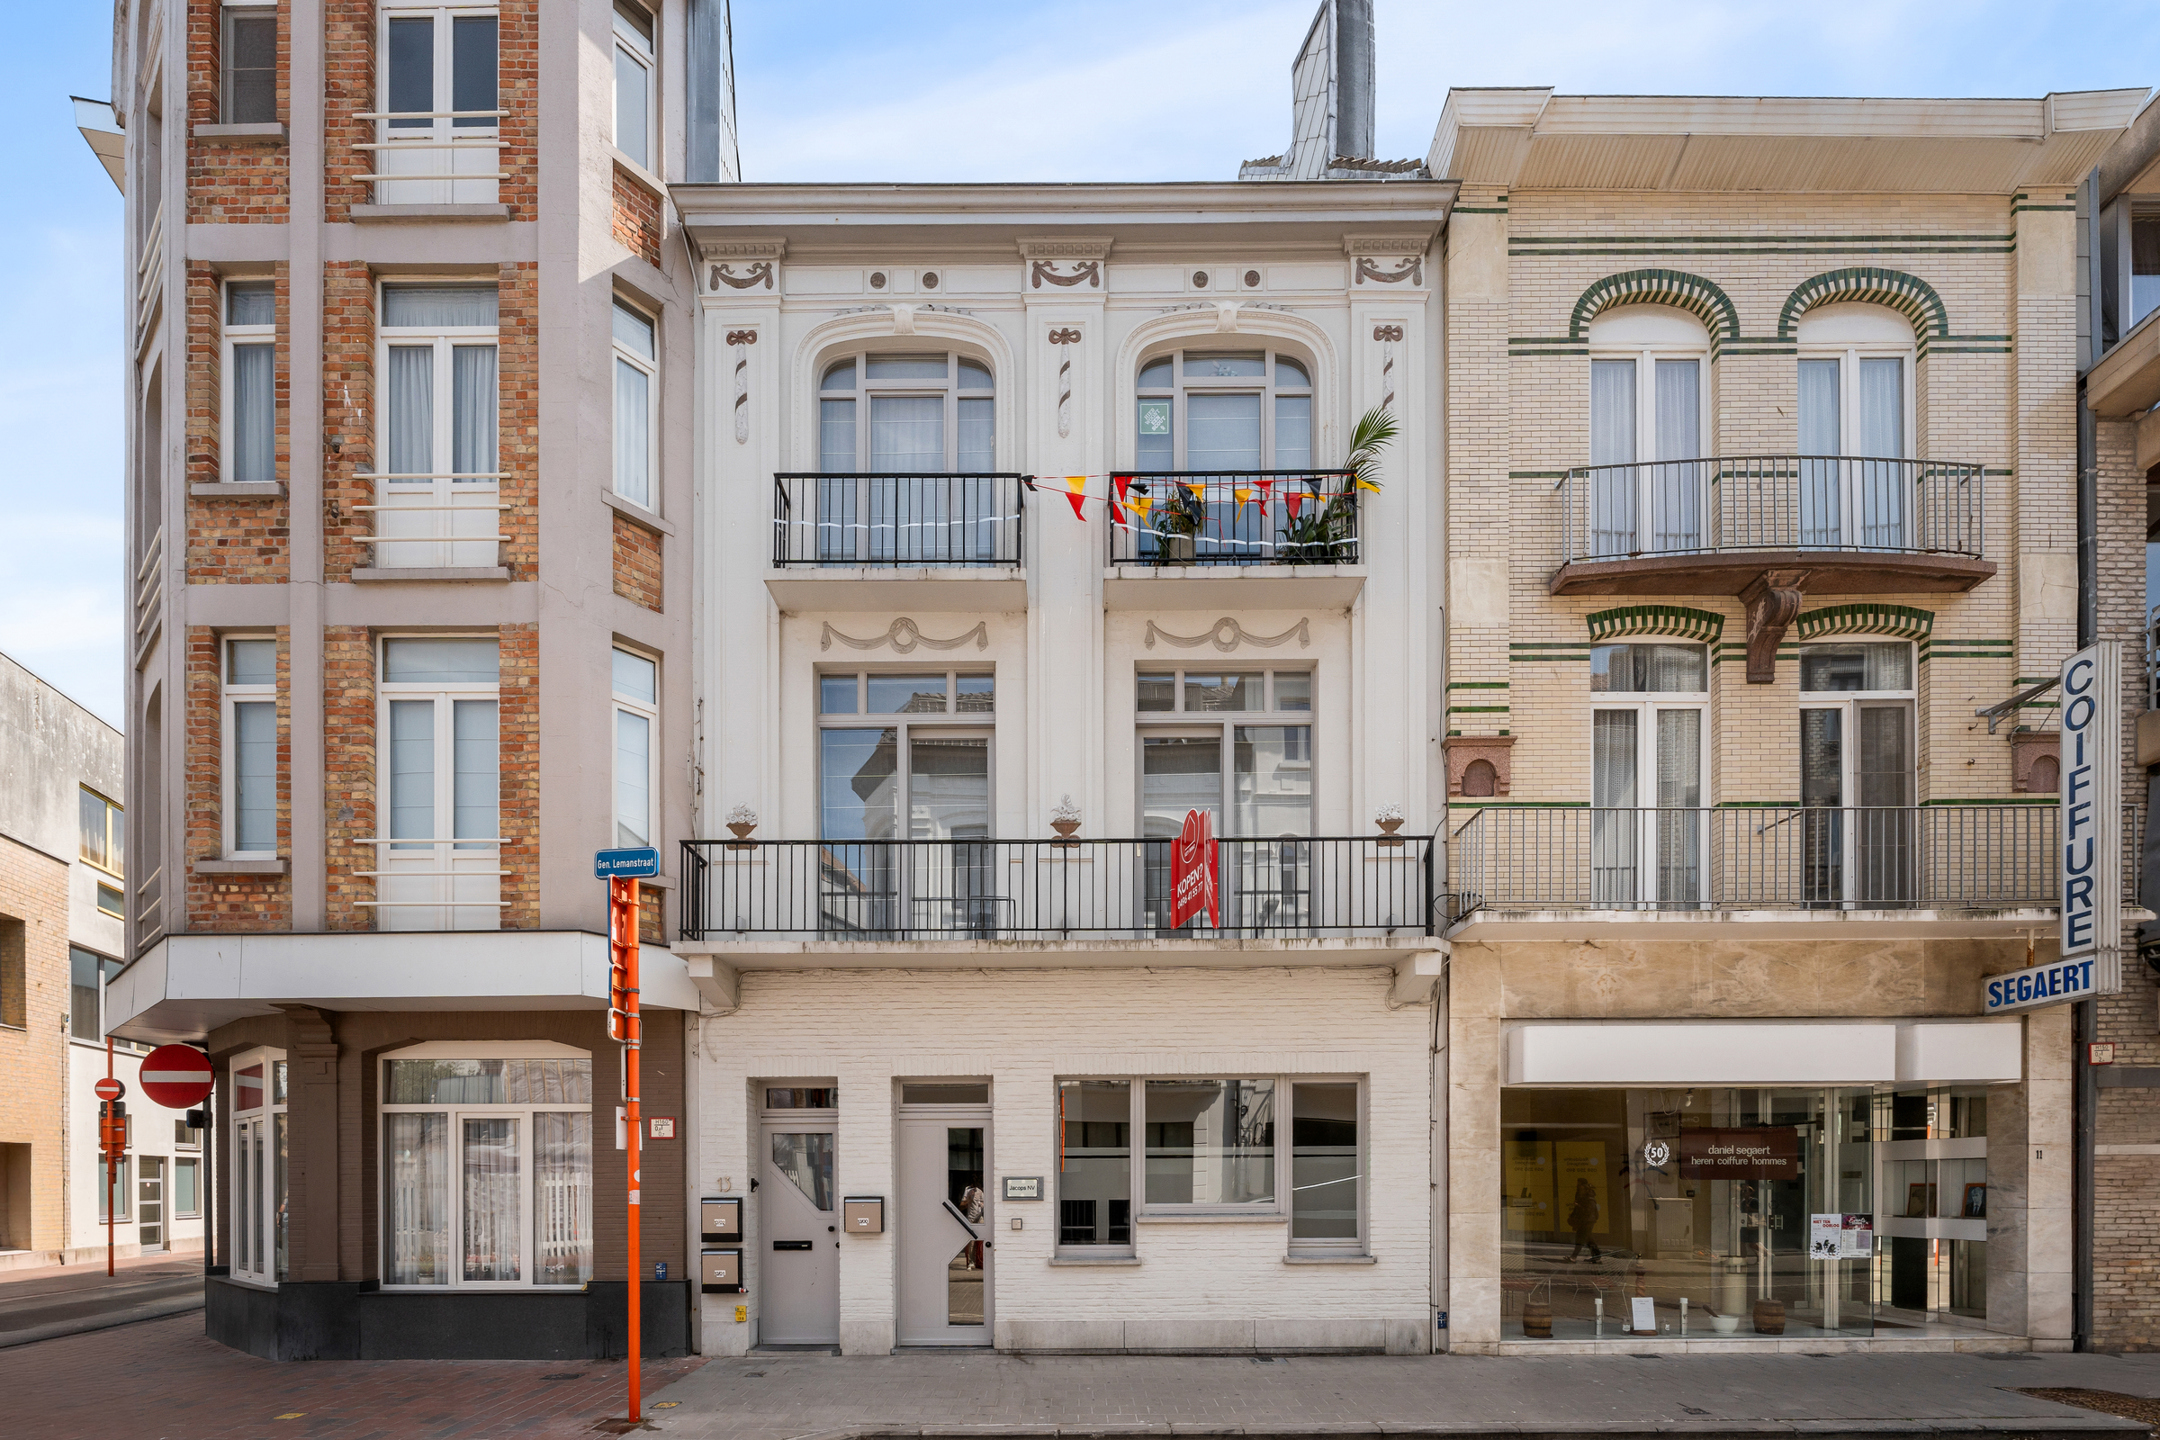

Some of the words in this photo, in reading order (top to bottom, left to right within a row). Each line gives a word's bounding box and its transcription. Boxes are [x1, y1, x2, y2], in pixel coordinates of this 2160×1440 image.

[1151, 415, 1166, 431] SCOUT
[2065, 659, 2096, 949] COIFFURE
[597, 859, 611, 869] Gen.
[612, 857, 654, 869] Lemanstraat
[1177, 863, 1204, 898] KOPEN?
[1177, 894, 1188, 910] 0496
[1987, 959, 2095, 1008] SEGAERT
[1651, 1147, 1663, 1158] 50
[1708, 1144, 1734, 1155] daniel
[1736, 1145, 1771, 1157] segaert
[2035, 1149, 2043, 1160] 11
[1691, 1156, 1714, 1165] heren
[1717, 1156, 1748, 1165] coiffure
[1751, 1156, 1787, 1165] hommes
[716, 1176, 731, 1193] 13
